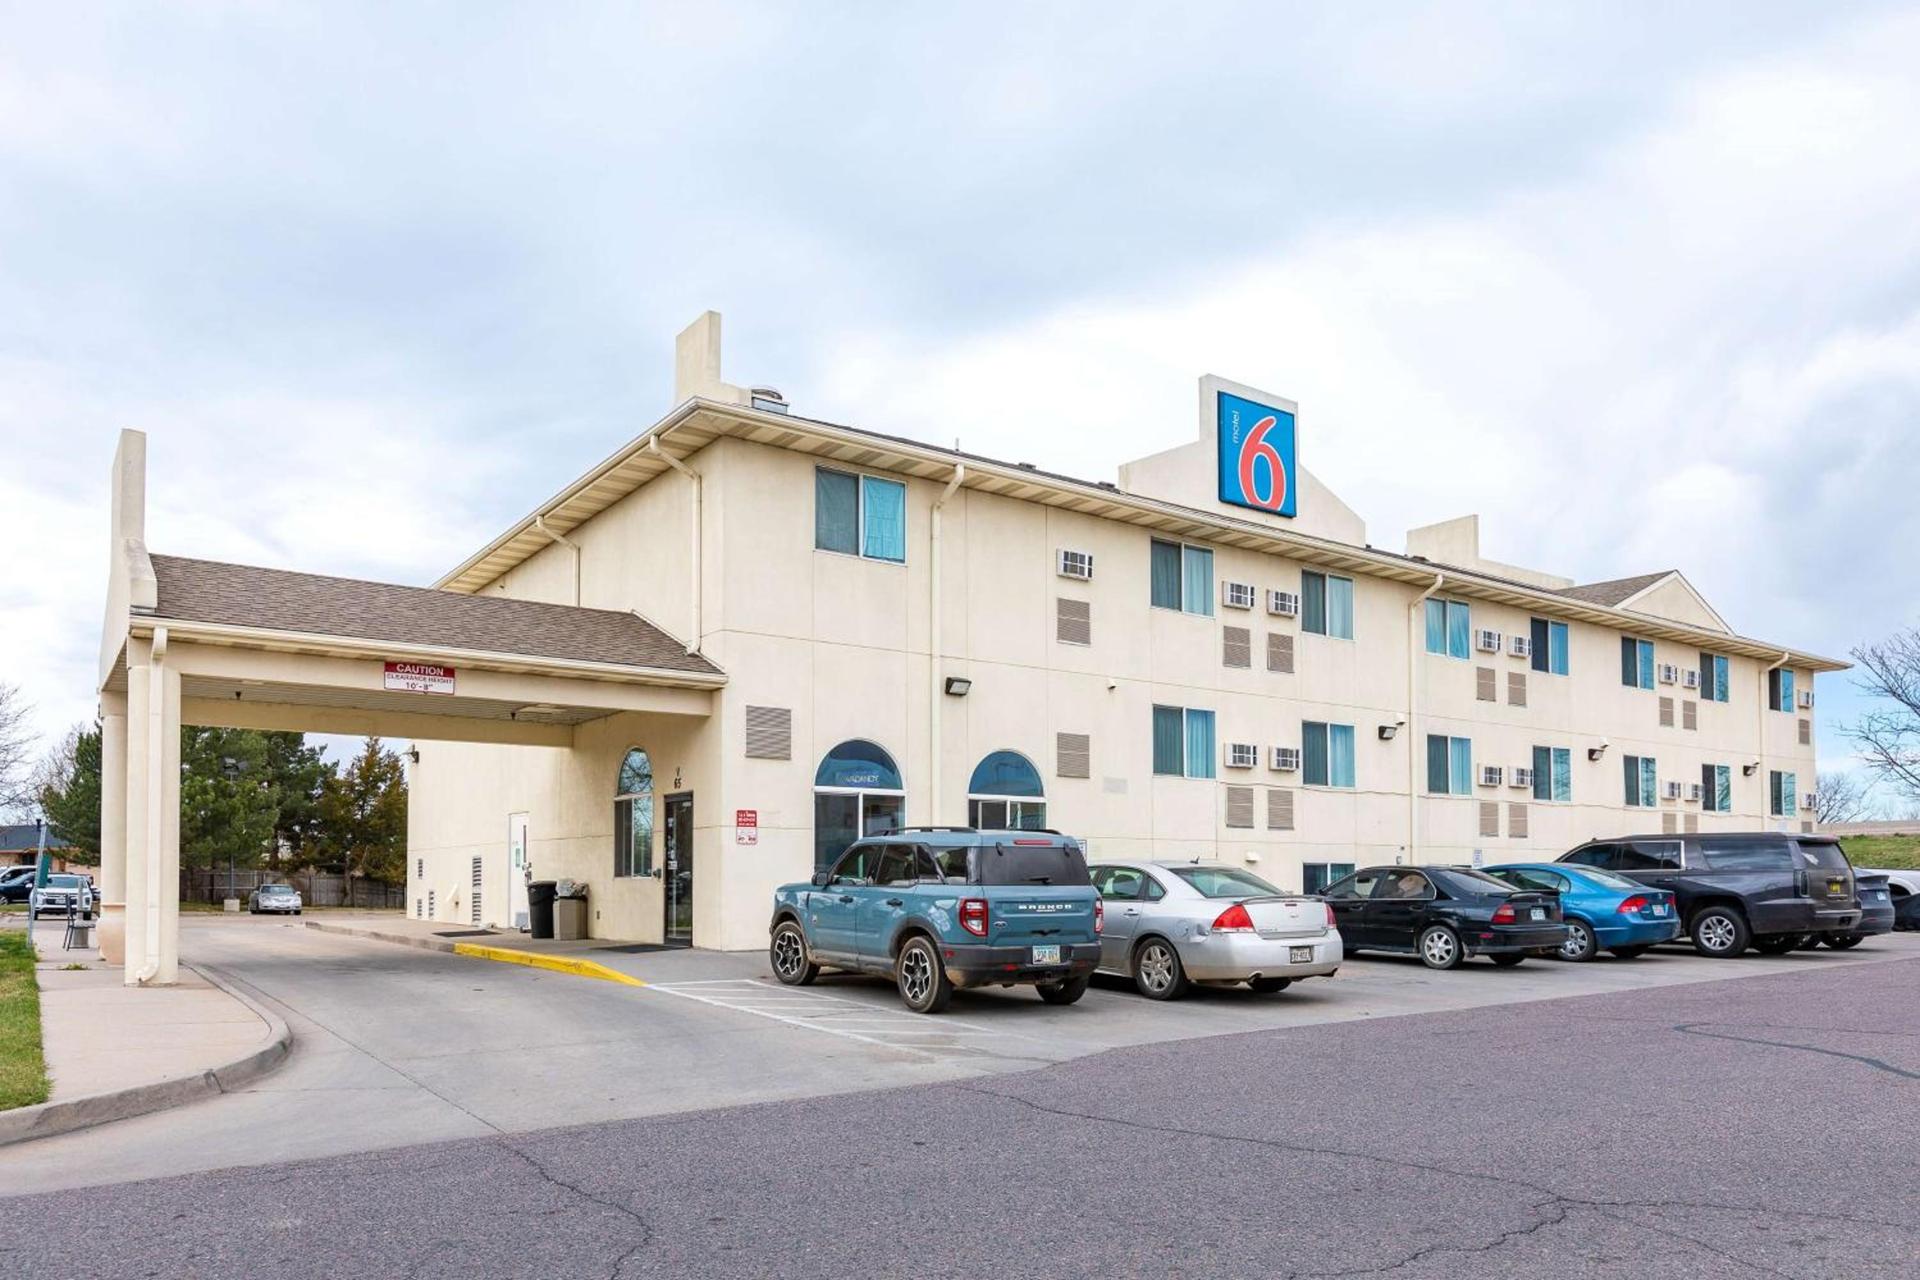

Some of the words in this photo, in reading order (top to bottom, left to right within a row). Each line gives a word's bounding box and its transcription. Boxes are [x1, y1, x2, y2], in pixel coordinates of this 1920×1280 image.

[1232, 410, 1240, 444] motel
[1238, 415, 1287, 511] 6
[396, 663, 444, 676] CAUTION
[386, 673, 427, 682] CLEARANCE
[428, 676, 452, 684] HEIGHT
